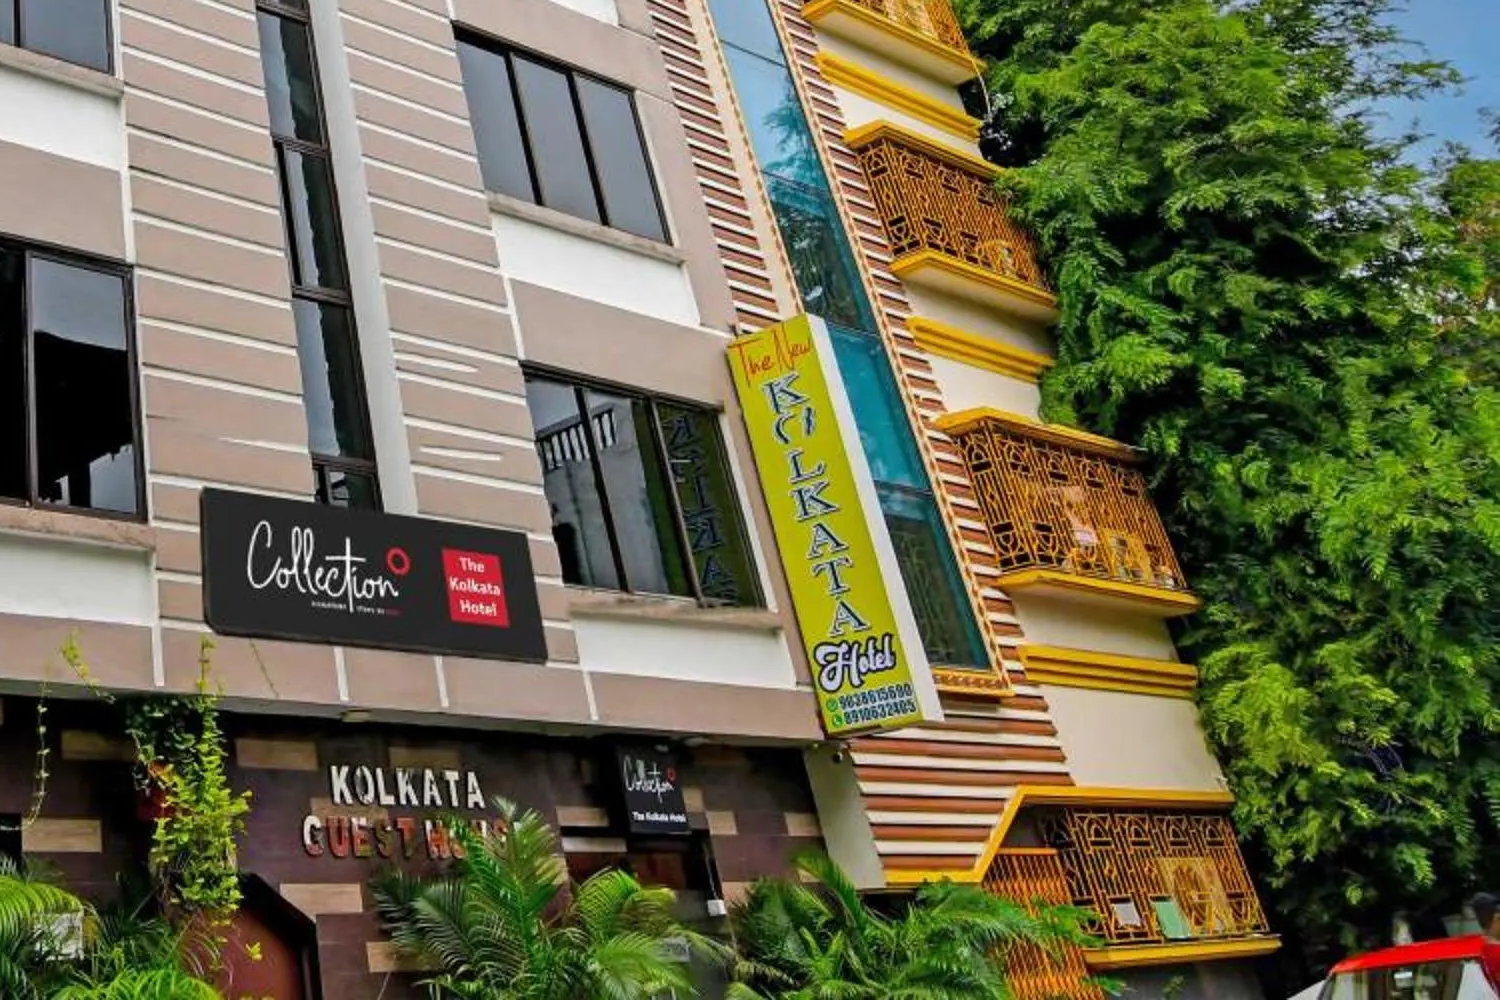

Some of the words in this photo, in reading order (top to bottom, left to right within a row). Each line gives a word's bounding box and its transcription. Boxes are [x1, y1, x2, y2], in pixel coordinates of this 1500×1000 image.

[727, 336, 773, 389] The
[771, 321, 811, 372] New
[761, 371, 869, 638] KOLKATA
[247, 520, 399, 613] Collection
[449, 576, 501, 596] Kolkata
[459, 556, 485, 573] The
[460, 599, 497, 617] Hotel
[813, 632, 897, 693] Hotel
[330, 765, 486, 809] KOLKATA
[303, 815, 416, 858] GUEST
